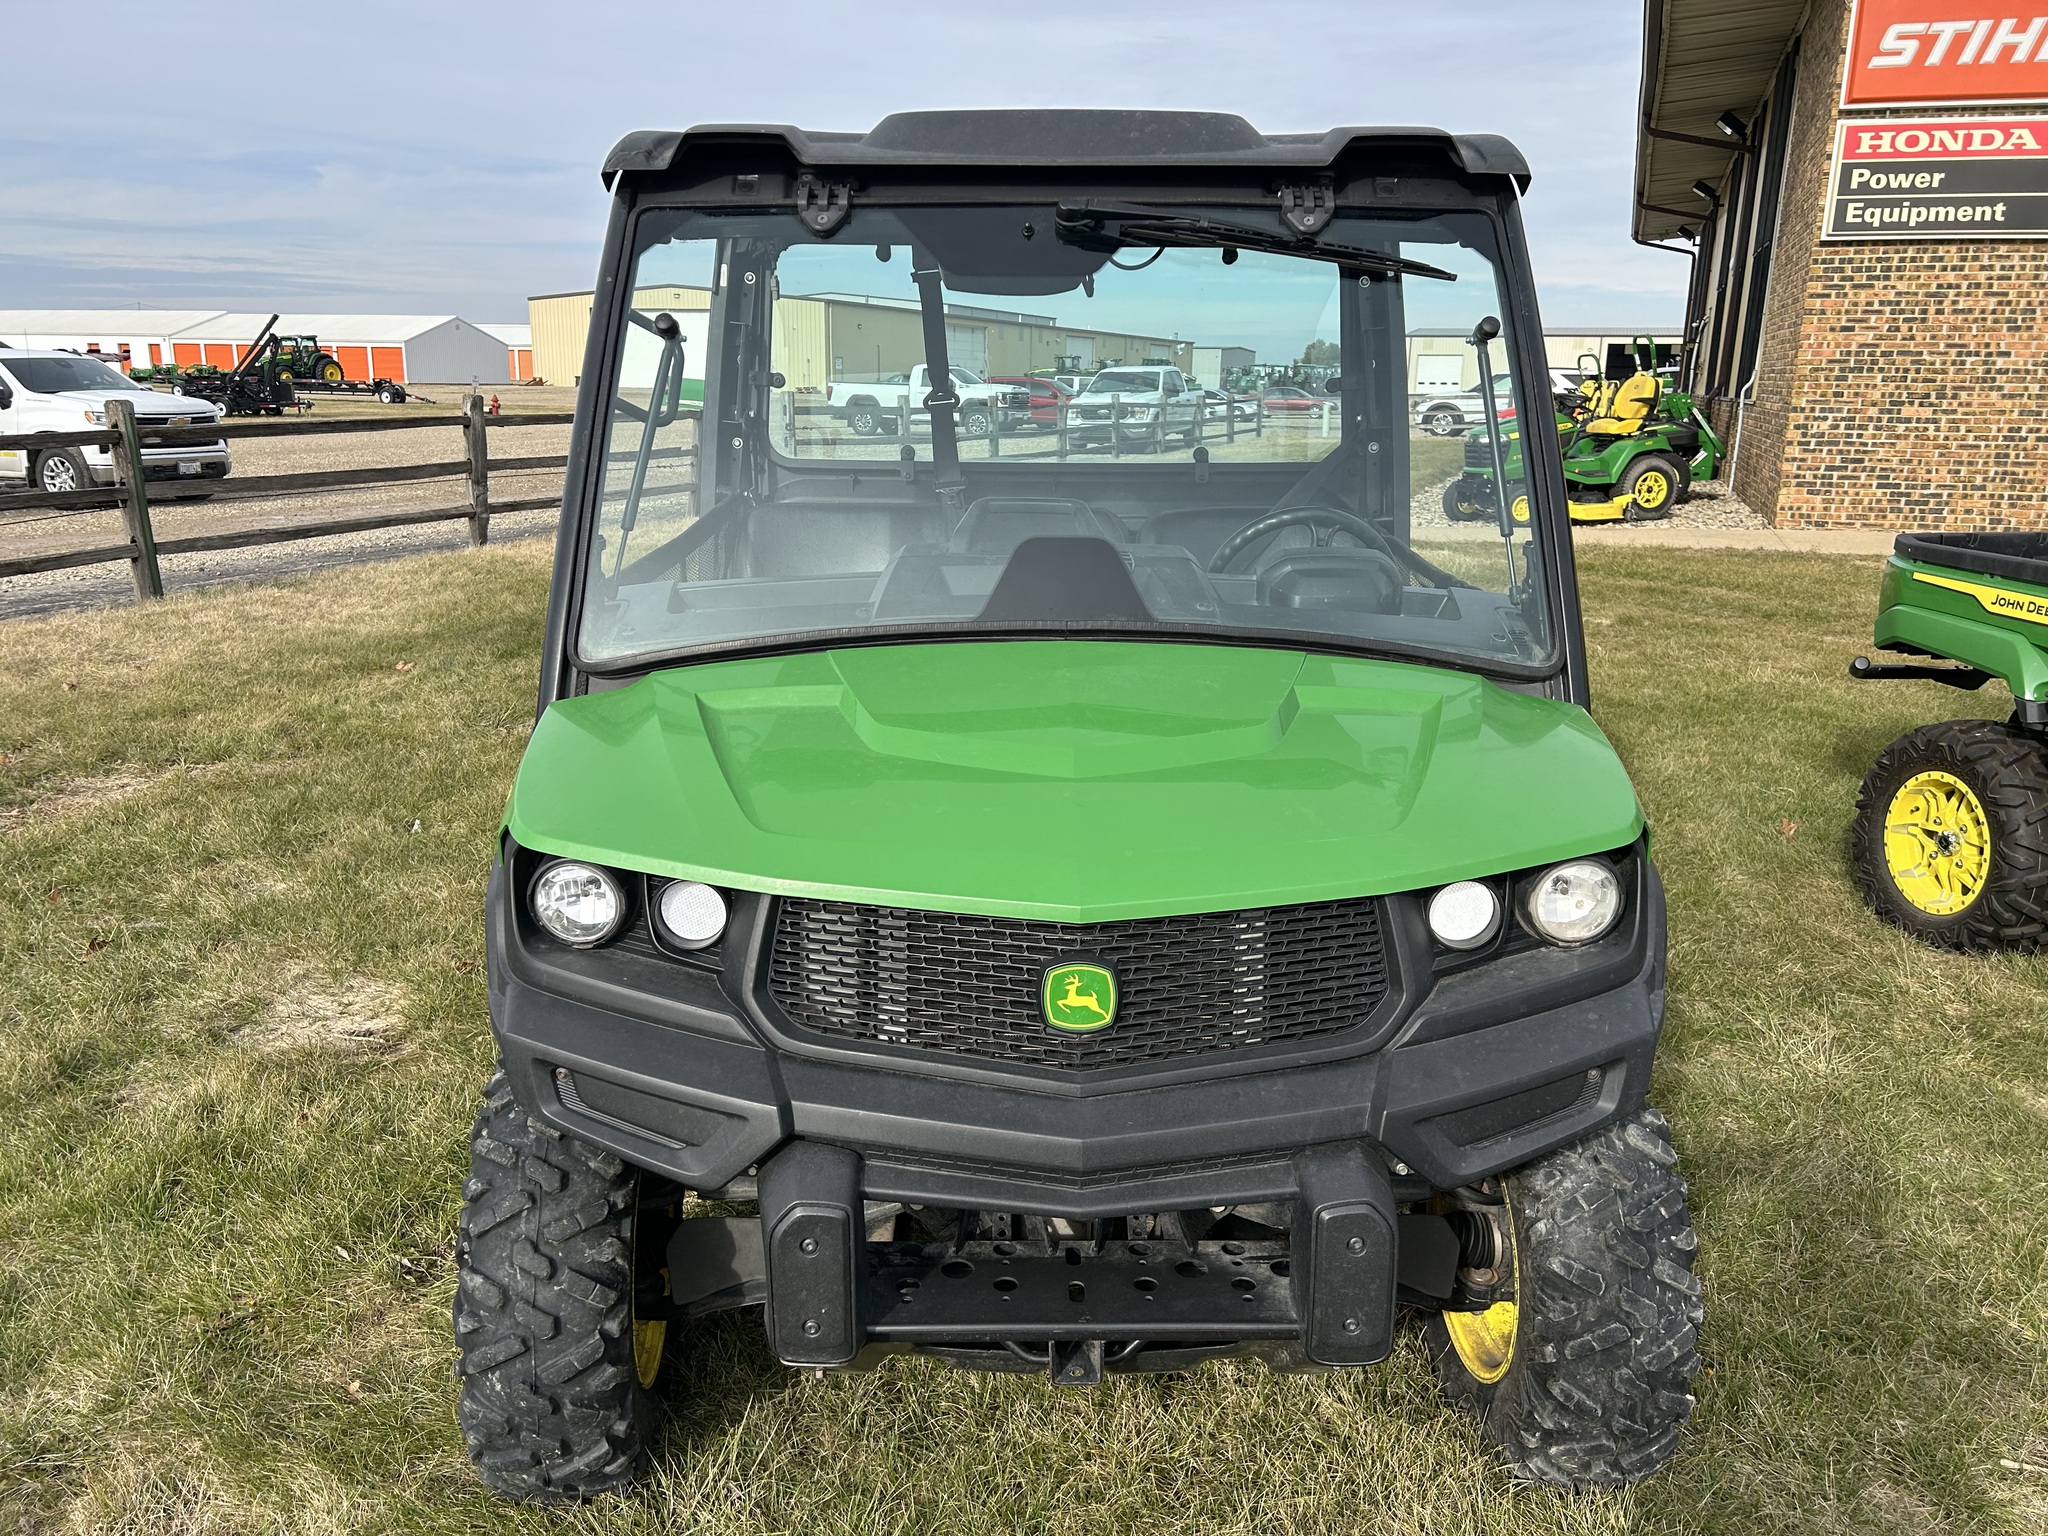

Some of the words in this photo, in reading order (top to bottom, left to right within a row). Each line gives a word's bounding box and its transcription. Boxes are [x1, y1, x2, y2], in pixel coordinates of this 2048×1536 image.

[1867, 16, 2048, 69] STIH
[1855, 128, 2042, 154] HONDA
[1850, 168, 1946, 190] Power
[1845, 201, 2007, 228] Equipment
[1991, 594, 2025, 612] JOHN
